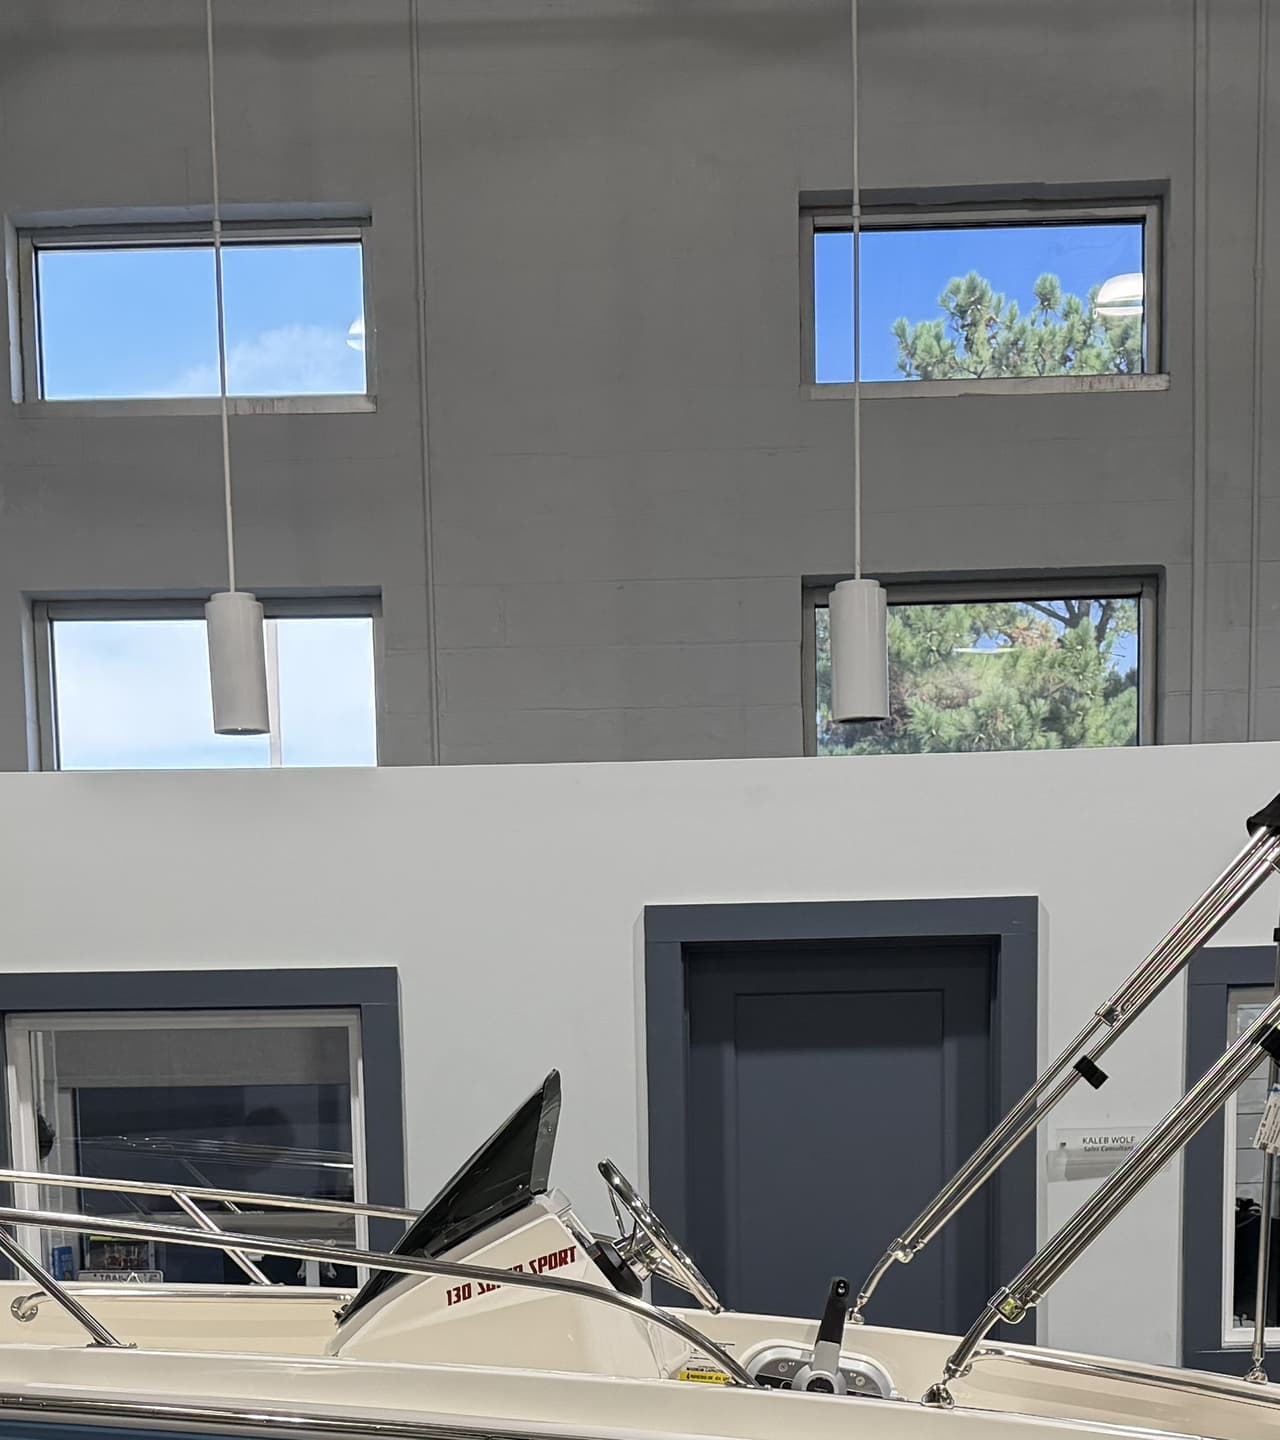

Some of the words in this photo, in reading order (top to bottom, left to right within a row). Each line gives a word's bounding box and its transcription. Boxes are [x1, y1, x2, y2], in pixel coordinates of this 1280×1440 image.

[1082, 1136, 1109, 1145] KALEB
[446, 1282, 472, 1306] 130
[528, 1245, 577, 1275] SPORT
